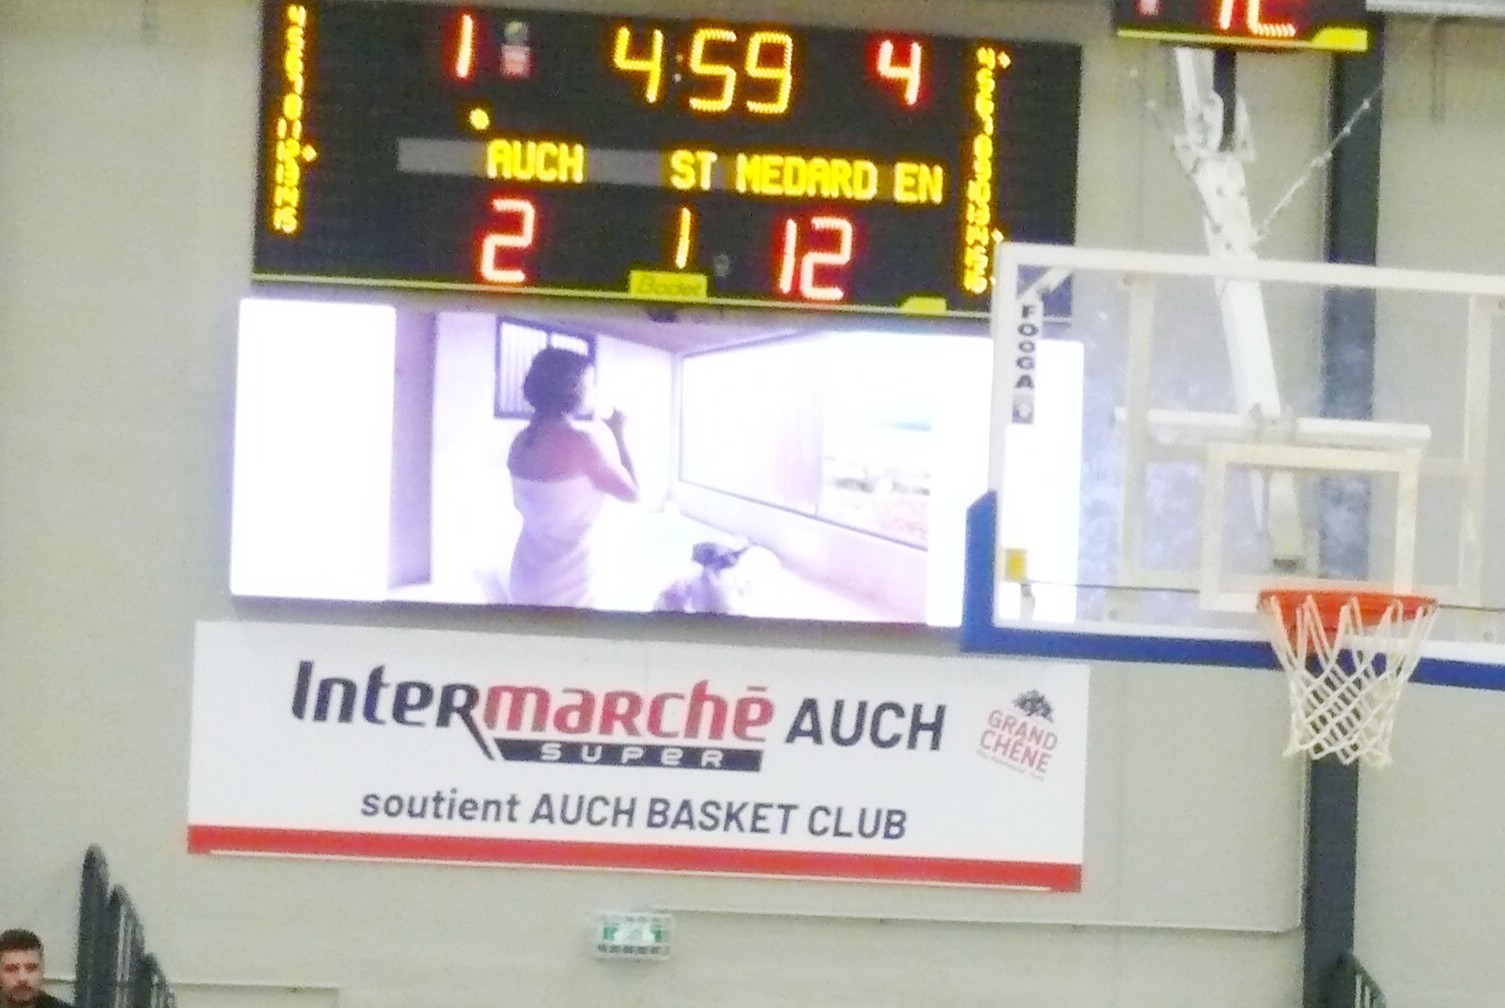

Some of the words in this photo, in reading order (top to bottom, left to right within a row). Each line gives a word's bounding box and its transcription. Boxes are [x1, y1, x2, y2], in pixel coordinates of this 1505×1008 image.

[455, 13, 474, 79] 1
[612, 25, 794, 114] 4:59
[877, 38, 923, 106] 4
[486, 139, 585, 184] AUCH
[670, 149, 718, 191] ST
[735, 153, 879, 201] MEDARD
[893, 164, 944, 205] EN
[479, 198, 536, 284] 2
[674, 206, 692, 270] 1
[779, 216, 854, 301] 12
[784, 697, 947, 753] AUCH
[988, 709, 1058, 751] GRAND
[359, 788, 519, 824] soutient
[530, 793, 637, 829] AUCH
[645, 796, 799, 836] BASKET
[806, 805, 908, 841] CLUB
